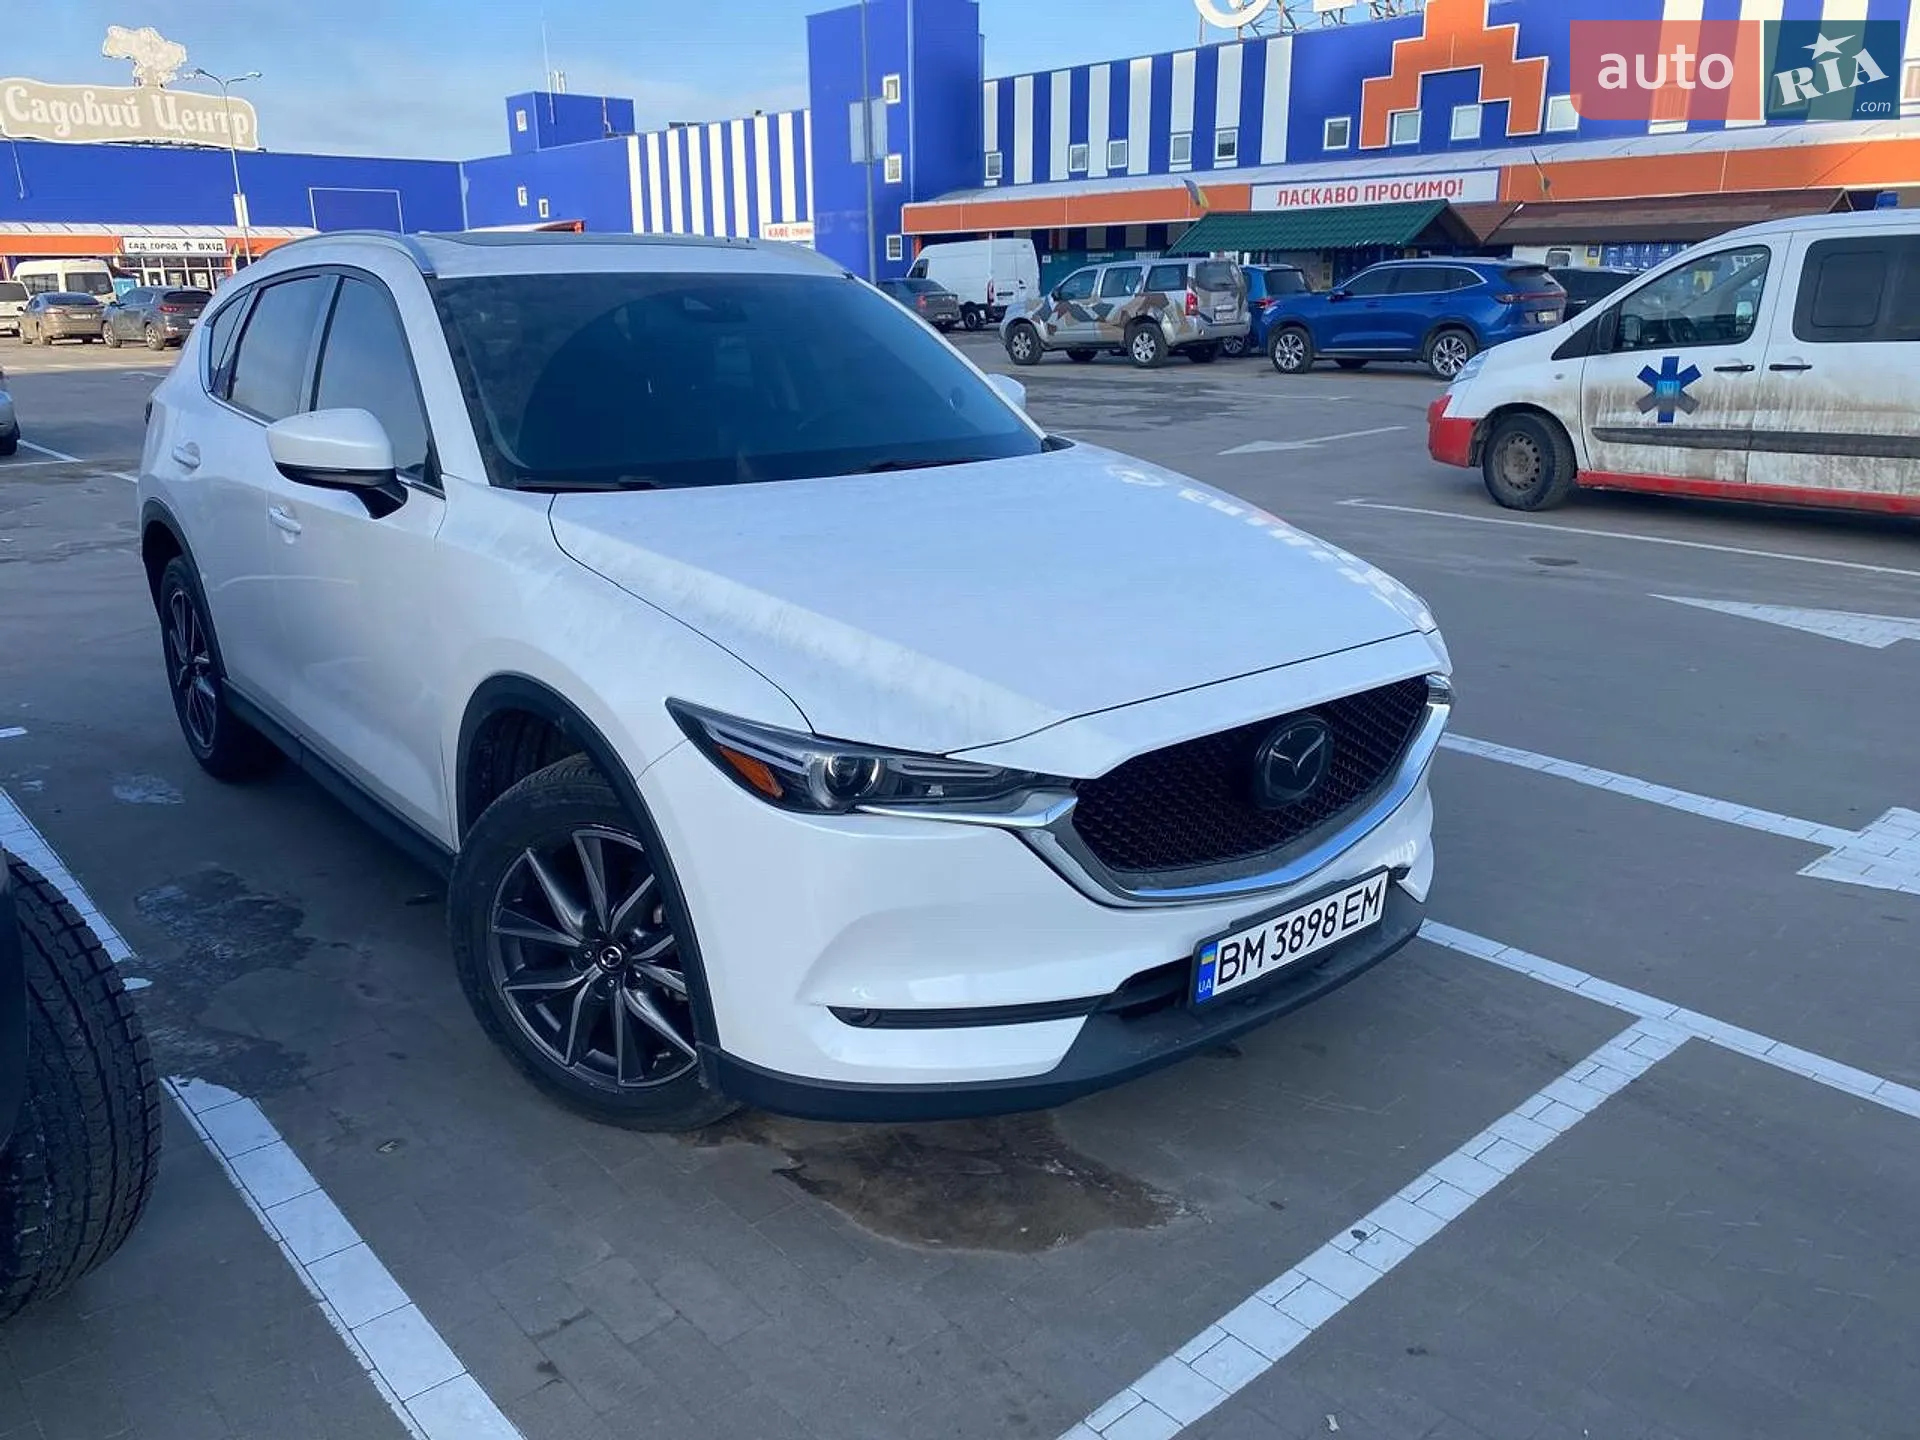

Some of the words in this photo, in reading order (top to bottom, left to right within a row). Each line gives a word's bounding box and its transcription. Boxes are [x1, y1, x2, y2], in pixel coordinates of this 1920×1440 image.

[4, 85, 142, 138] Садовий
[150, 95, 249, 144] Центр
[1277, 185, 1358, 206] ЛАСКАВО
[1364, 178, 1464, 202] ПРОСИМО!
[1217, 930, 1266, 986] BM
[1270, 901, 1338, 961] 3898
[1341, 880, 1382, 931] EM
[1198, 979, 1212, 993] UA
